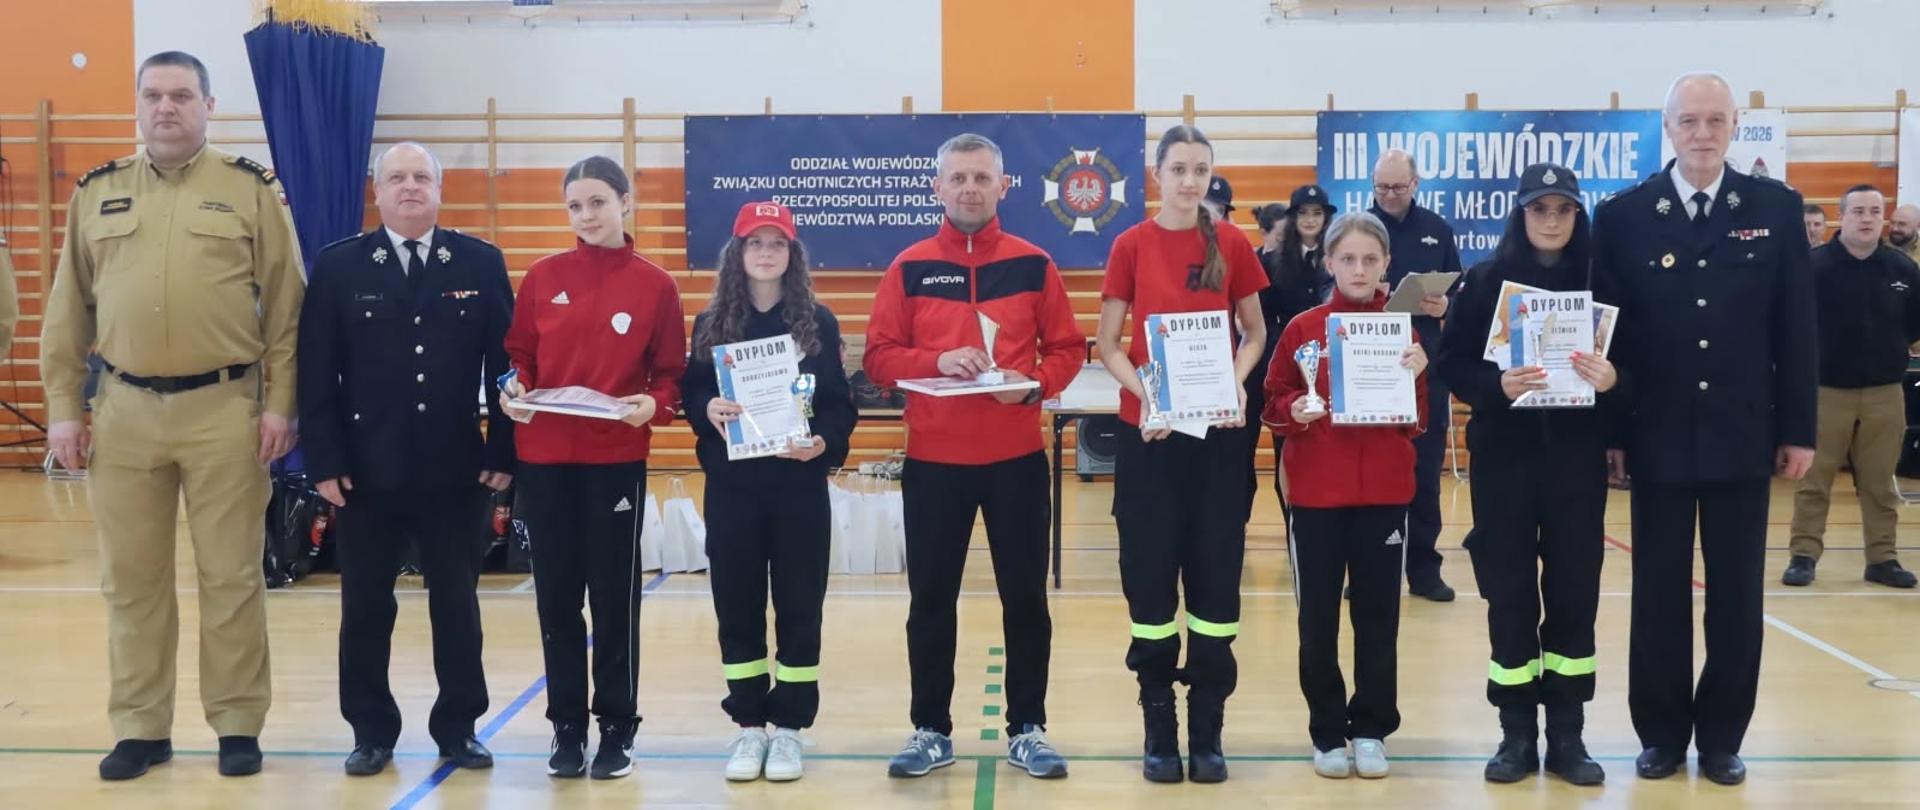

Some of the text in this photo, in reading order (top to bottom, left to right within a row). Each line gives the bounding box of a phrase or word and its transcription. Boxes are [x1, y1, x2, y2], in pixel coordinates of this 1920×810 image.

[1743, 126, 1773, 142] 2026
[791, 154, 940, 170] ODDZIAŁ WOJEWÓDZK
[1334, 132, 1367, 180] III
[713, 173, 936, 192] ZWIĄZKU OCHOTNICZYCH STRAŻY
[772, 194, 900, 207] RZECZYPOSPOLITEJ
[792, 211, 876, 226] JEWÓDZTWA
[878, 212, 945, 226] PODLASKI
[922, 275, 965, 285] GIVOVA
[1531, 297, 1585, 312] DYPLOM
[1170, 316, 1222, 332] DYPLOM
[1350, 322, 1401, 336] DYPLOM
[735, 341, 787, 361] DYPLOM
[928, 744, 943, 762] N
[1017, 745, 1029, 762] N
